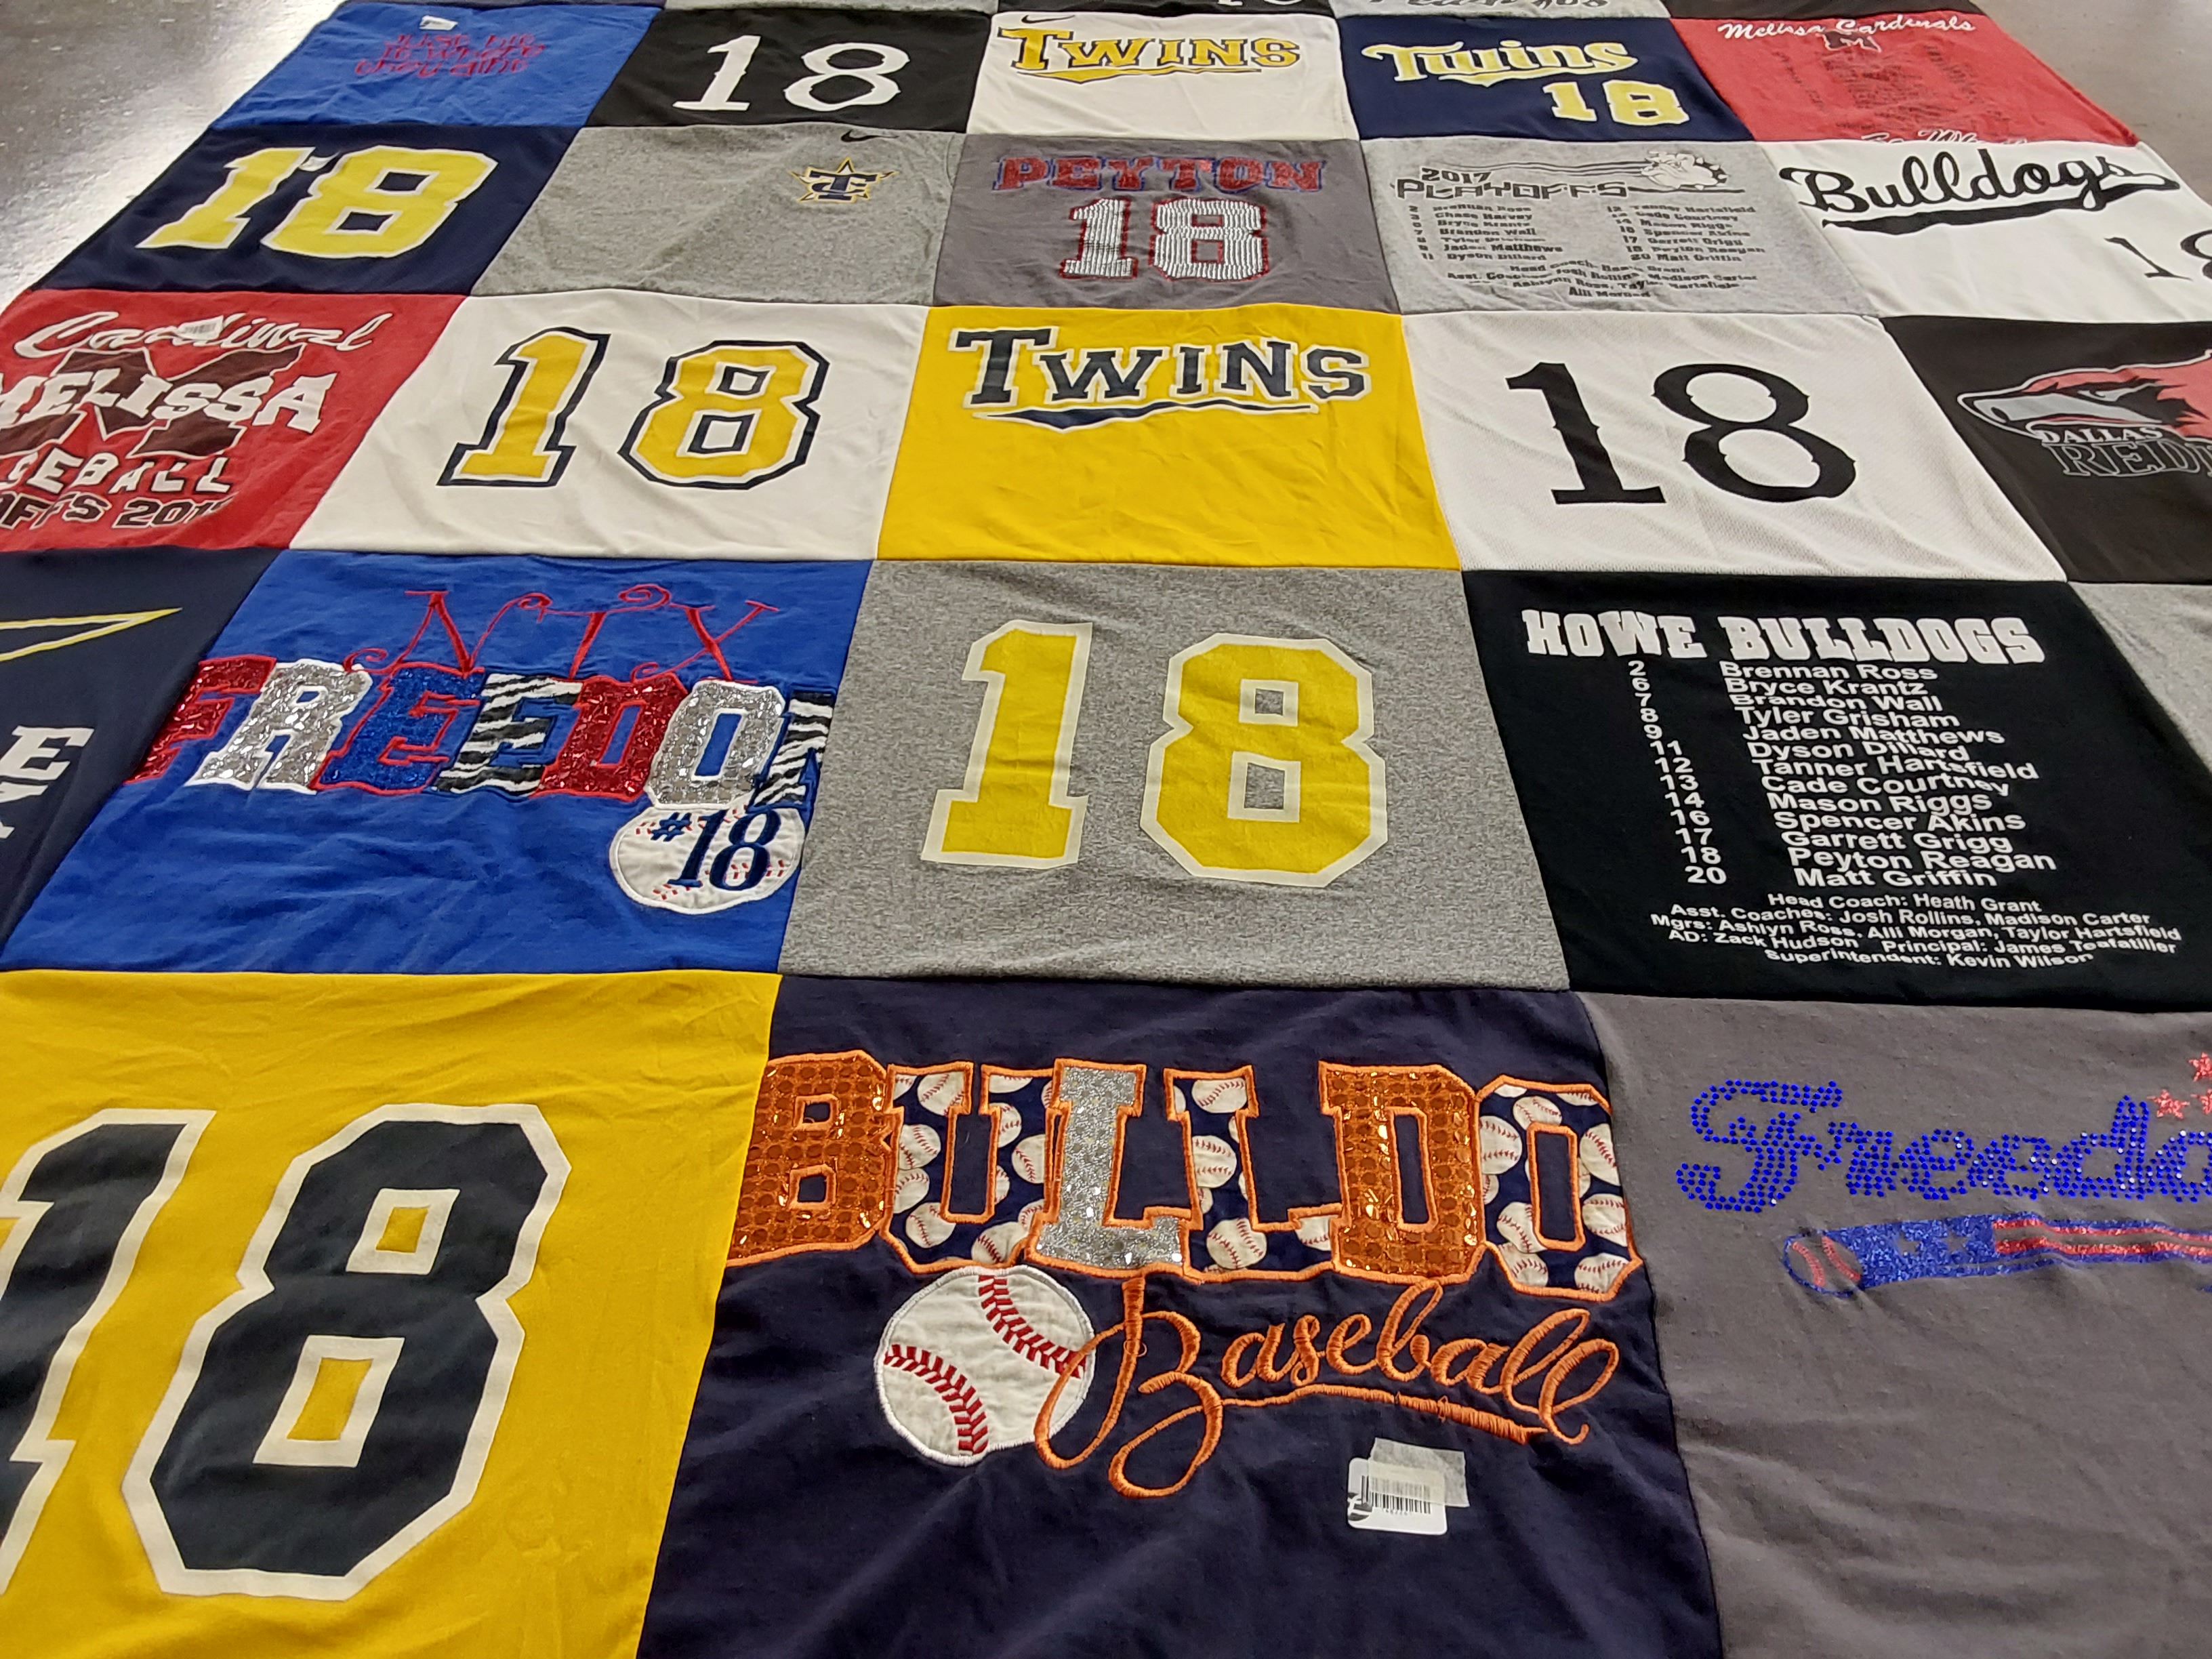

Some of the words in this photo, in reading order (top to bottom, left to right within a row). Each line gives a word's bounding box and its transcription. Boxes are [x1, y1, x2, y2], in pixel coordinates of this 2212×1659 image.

[1717, 22, 1824, 39] Melissa
[1835, 14, 1976, 35] Cardinals
[672, 35, 911, 112] 18
[1361, 40, 1639, 83] Twins
[1542, 79, 1690, 127] 18
[993, 155, 1328, 193] PEYTON
[1421, 167, 1492, 184] 2017
[1779, 148, 2179, 210] Bulldogs
[136, 144, 499, 260] 18
[1396, 181, 1628, 200] PLAYOFFS
[1059, 196, 1269, 281] 18
[436, 326, 831, 490] 18
[1504, 361, 1857, 505] 18
[2040, 426, 2165, 444] DALLAS
[1520, 609, 1707, 659] HOWE
[1717, 615, 2047, 663] BULLDOGS
[1628, 660, 1646, 676] 2
[1719, 660, 1850, 678] Brennan
[1856, 663, 1939, 680] Ross
[1631, 676, 1651, 691] 6
[1724, 677, 1816, 697] Bryce
[1822, 679, 1929, 695] Krantz
[1634, 692, 1652, 707] 7
[1728, 693, 1868, 710] Brandon
[1871, 695, 1944, 712] Wall
[1640, 708, 1660, 722] 8
[1734, 706, 1814, 729] Tyler
[1822, 708, 1961, 728] Grisham
[1643, 724, 1663, 740] 9
[1742, 725, 1842, 741] Jaden
[1847, 725, 2006, 744] Matthews
[920, 618, 1389, 888] 18
[1650, 739, 1683, 756] 11
[1746, 741, 1855, 761] Dyson
[1862, 741, 1971, 762] Dillard
[1654, 757, 1694, 773] 12
[1751, 758, 1868, 777] Tanner
[1877, 755, 2040, 779] Hartsfield
[1660, 774, 1699, 791] 13
[1761, 775, 1849, 794] Cade
[1856, 772, 2009, 797] Courtney
[1664, 792, 1706, 808] 14
[1766, 792, 1883, 813] Mason
[1888, 794, 1993, 817] Riggs
[1670, 809, 1711, 826] 16
[1773, 811, 1917, 833] Spencer
[1927, 813, 2027, 832] Akins
[650, 808, 782, 892] #18
[1675, 827, 1713, 845] 17
[1780, 831, 1907, 850] Garrett
[1912, 832, 2014, 854] Grigg
[1681, 846, 1722, 865] 18
[1787, 846, 1913, 873] Peyton
[1920, 850, 2057, 873] Reagan
[1684, 865, 1727, 884] 20
[1793, 867, 1877, 887] Matt
[1882, 869, 1998, 886] Griffin
[1670, 903, 1726, 918] Asst.
[1730, 907, 1834, 922] Coaches:
[1839, 909, 1893, 924] Josh
[1898, 909, 1982, 926] Rollins,
[1984, 912, 2078, 926] Madison
[2082, 912, 2150, 926] Carter
[1767, 893, 1824, 909] Head
[1828, 894, 1909, 909] Coach:
[1912, 893, 1976, 912] Heath
[1980, 897, 2043, 913] Grant
[1650, 913, 1713, 931] Mgrs:
[1719, 918, 1794, 937] Ashlyn
[1867, 925, 1904, 939] Alli
[1907, 926, 1999, 940] Morgan,
[2001, 926, 2070, 943] Taylor
[2074, 924, 2183, 941] Hartsfield
[1668, 929, 1708, 943] AD:
[1713, 932, 1768, 947] Zack
[1771, 935, 1860, 949] Hudson
[1881, 939, 1988, 954] Principal:
[1993, 939, 2066, 955] James
[1763, 948, 1943, 966] Superintendent:
[1946, 953, 2011, 969] Kevin
[2013, 953, 2094, 968] Wilson
[1035, 1277, 1621, 1499] Baseball
